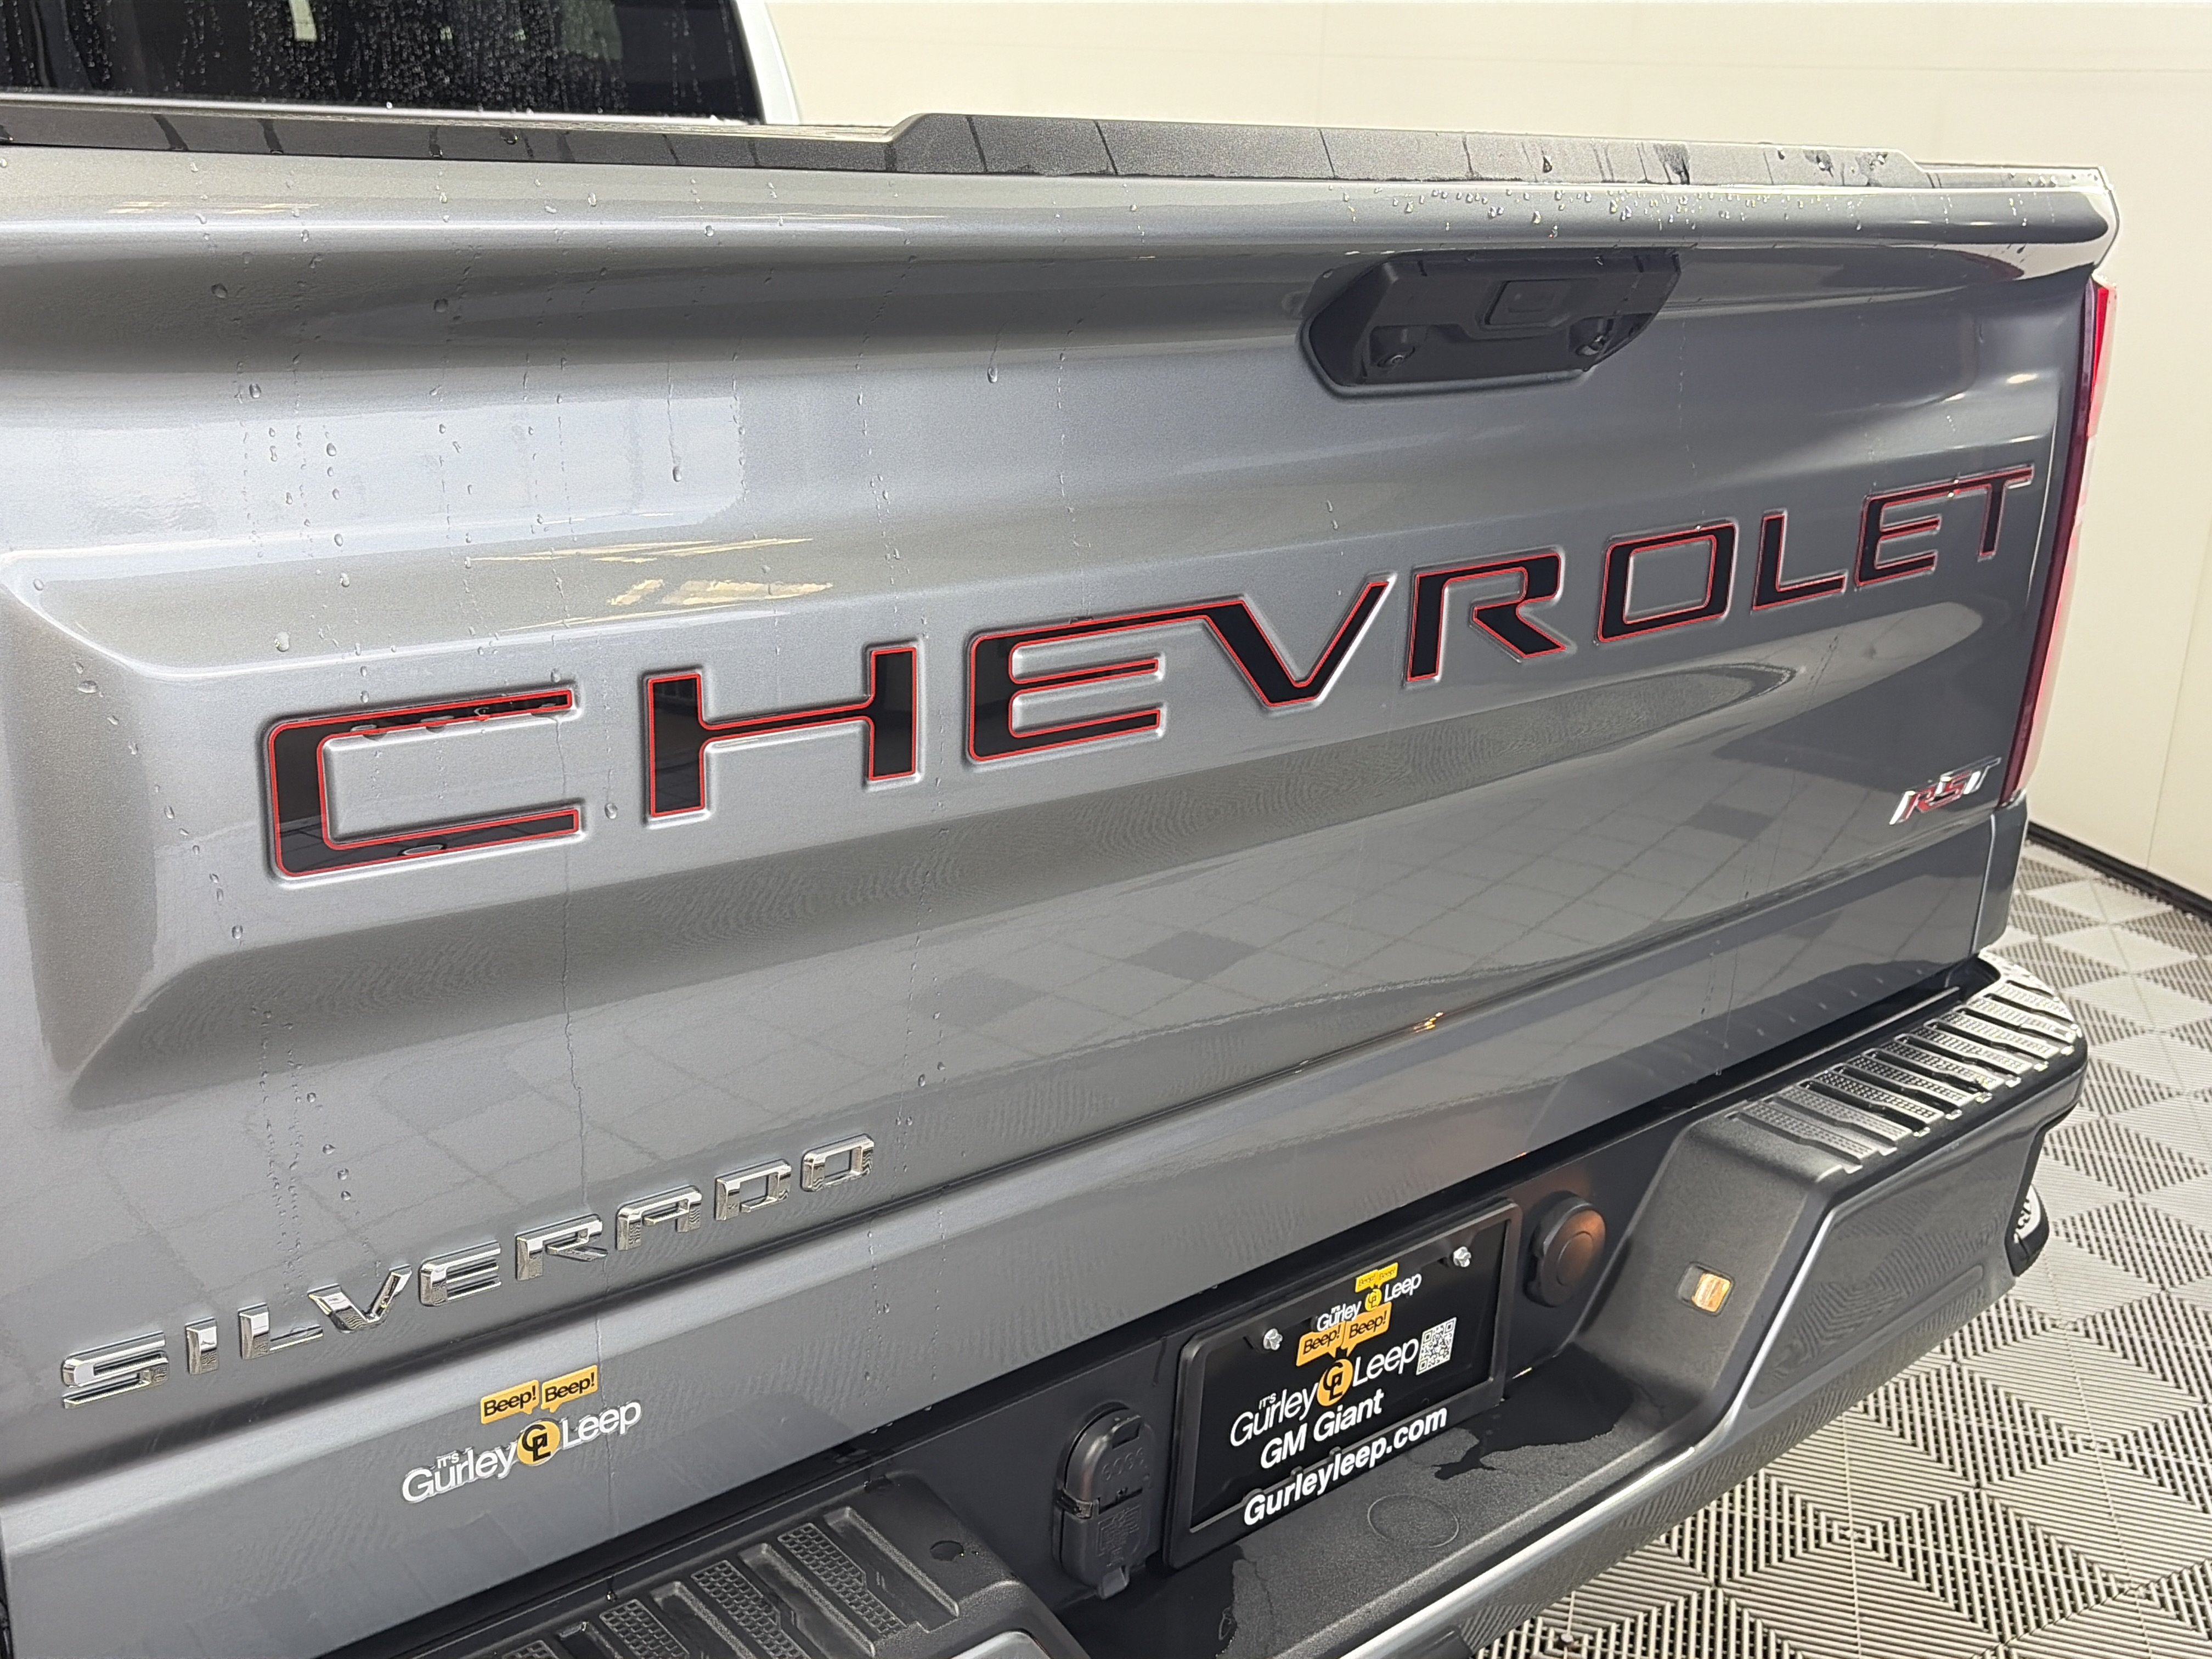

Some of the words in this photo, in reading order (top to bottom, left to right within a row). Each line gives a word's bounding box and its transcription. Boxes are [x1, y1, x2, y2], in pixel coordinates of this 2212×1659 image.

[267, 464, 2034, 878] CHEVROLET
[1888, 757, 2001, 825] RST
[61, 1133, 876, 1409] SILVERADO
[1317, 1301, 1362, 1331] Gurley
[1384, 1273, 1422, 1302] Leep
[1302, 1325, 1340, 1355] Beep!
[1349, 1310, 1387, 1339] Beep!
[483, 1385, 537, 1417] Beep!
[545, 1372, 595, 1403] Beep!
[1230, 1381, 1319, 1447] Gurley
[1352, 1338, 1419, 1387] Leep
[1259, 1392, 1277, 1410] IT'S
[1260, 1423, 1308, 1469] GM
[1313, 1388, 1384, 1442] Giant
[402, 1441, 518, 1503] Gurley
[562, 1402, 641, 1448] Leep
[1244, 1407, 1447, 1526] Gurleyleep.com
